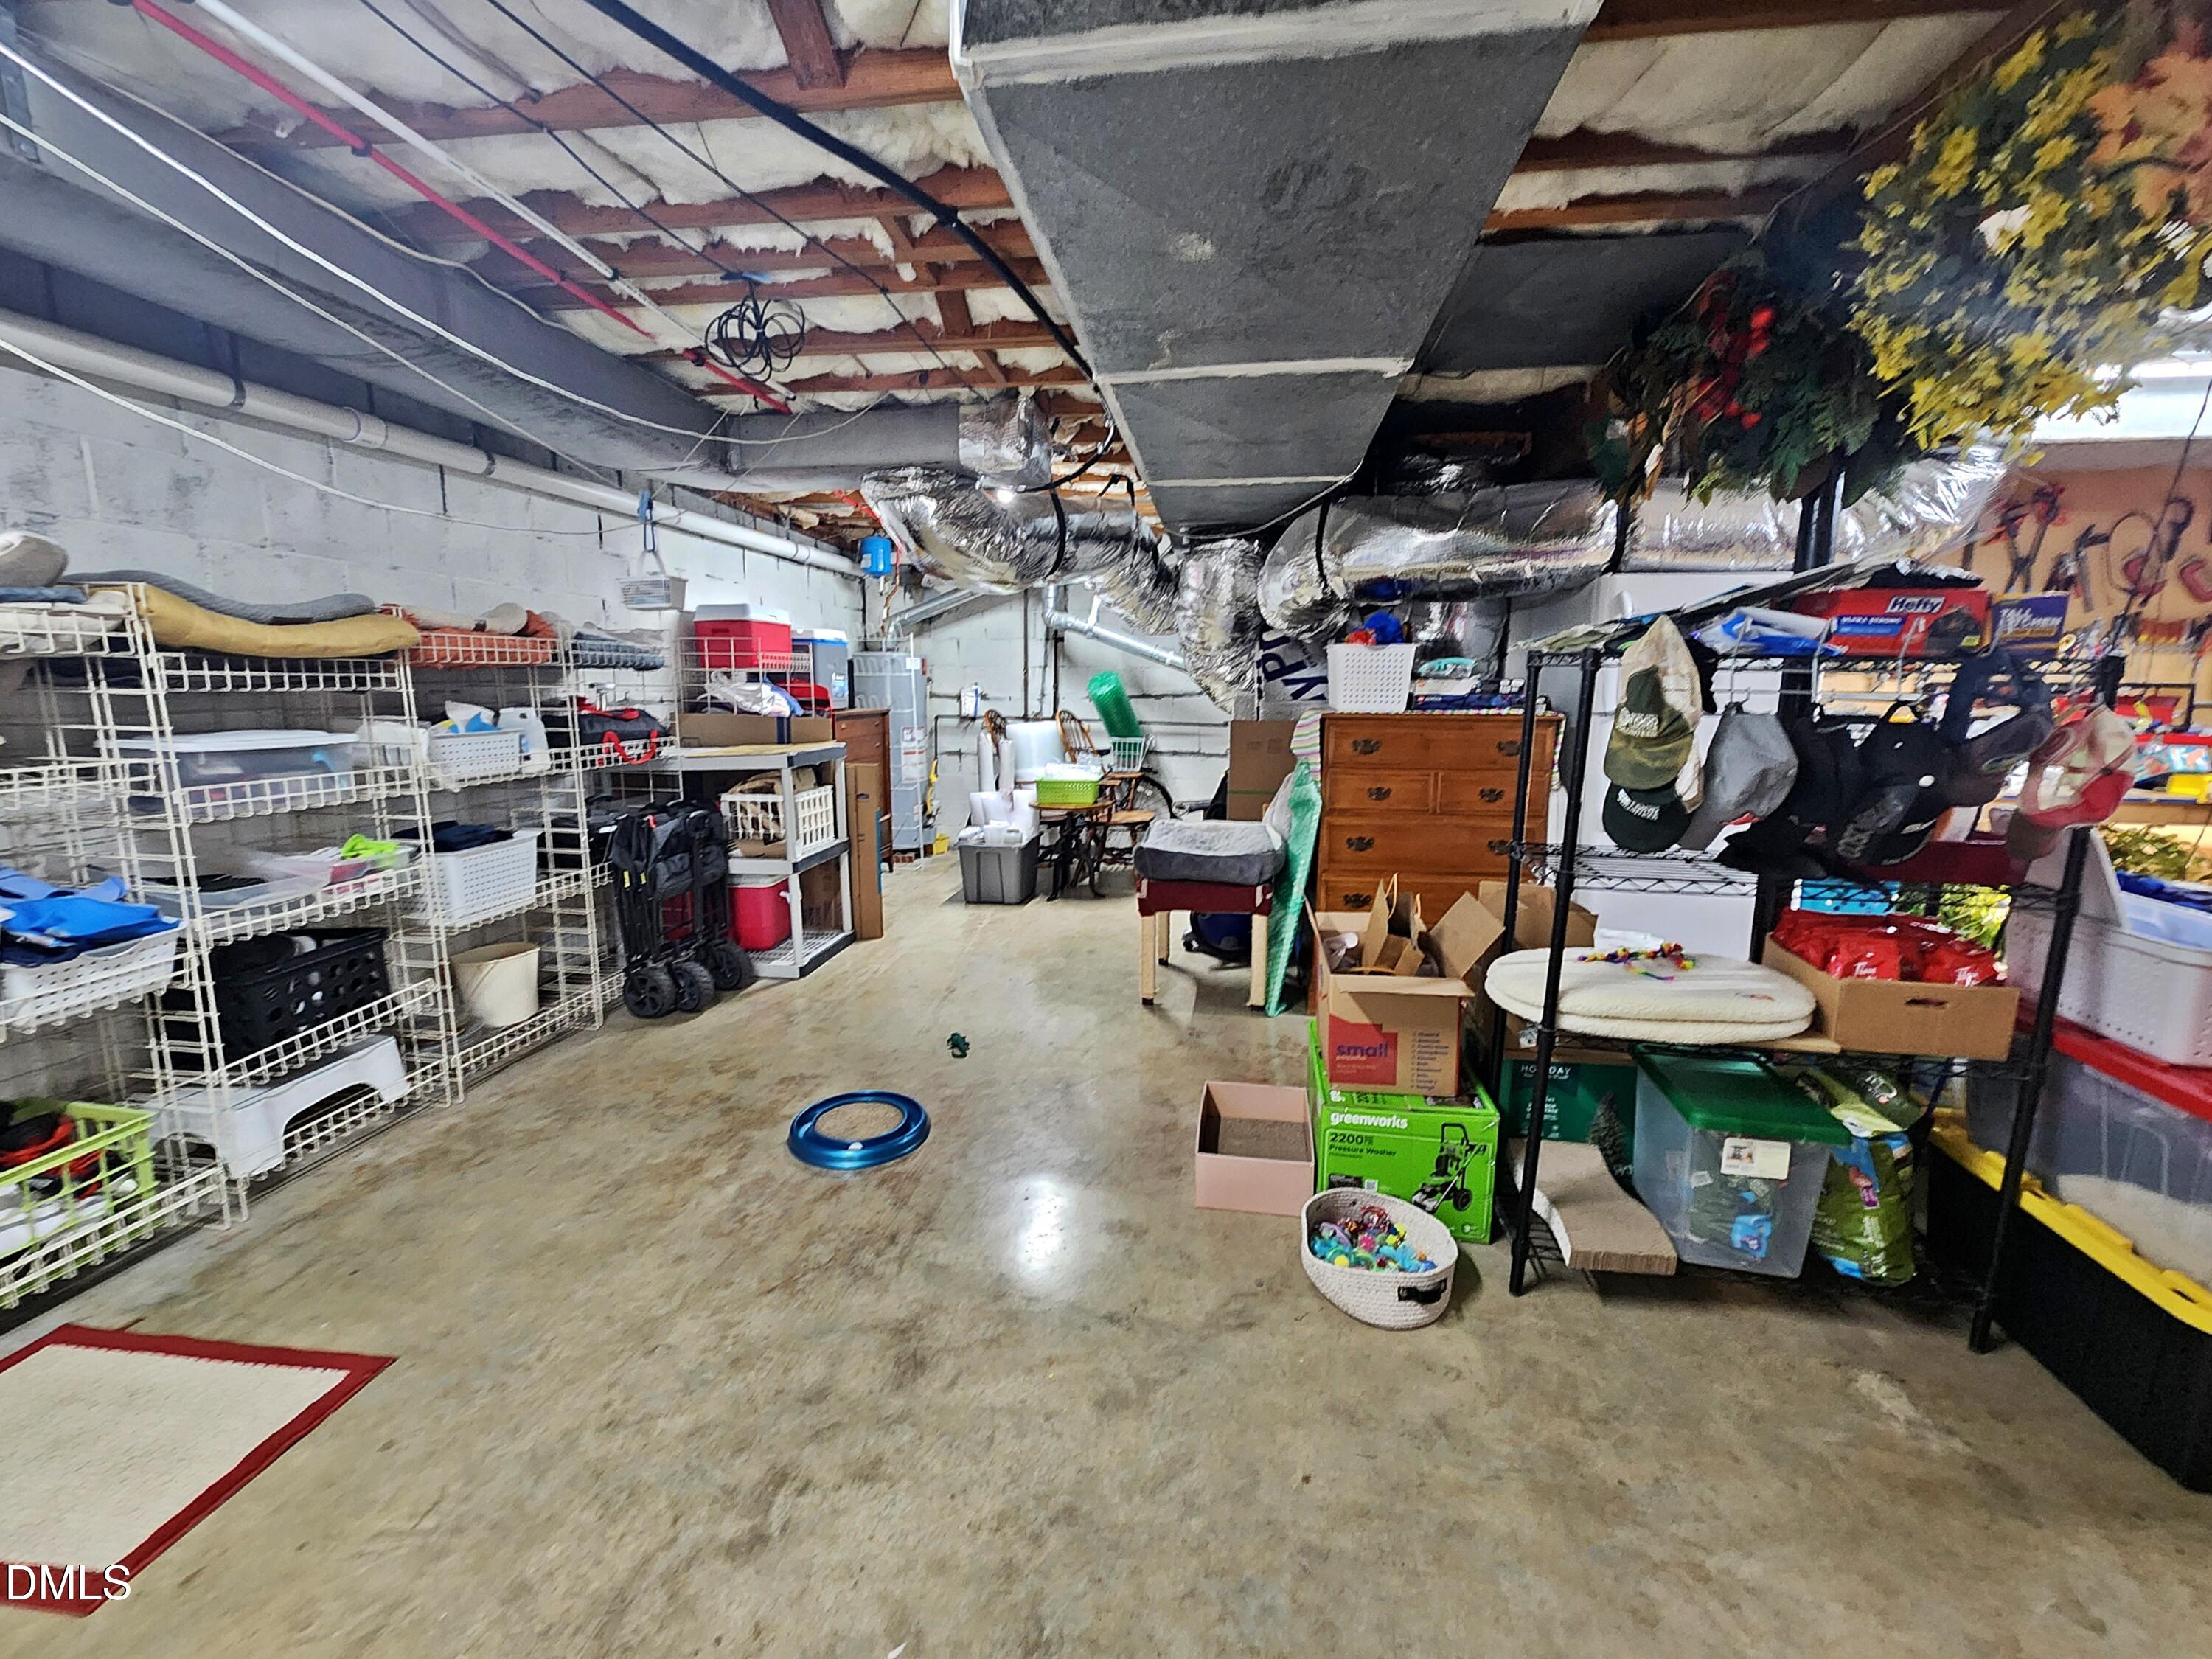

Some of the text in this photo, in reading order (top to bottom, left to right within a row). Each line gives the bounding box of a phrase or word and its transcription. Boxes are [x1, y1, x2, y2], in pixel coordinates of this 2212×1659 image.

[1890, 596, 1941, 613] Hefty
[1336, 1042, 1389, 1058] small
[1520, 1064, 1572, 1075] HODAY
[1329, 1110, 1408, 1130] greenworks
[1329, 1132, 1364, 1145] 2200
[1329, 1144, 1364, 1154] Pressure
[1366, 1147, 1397, 1157] Washer
